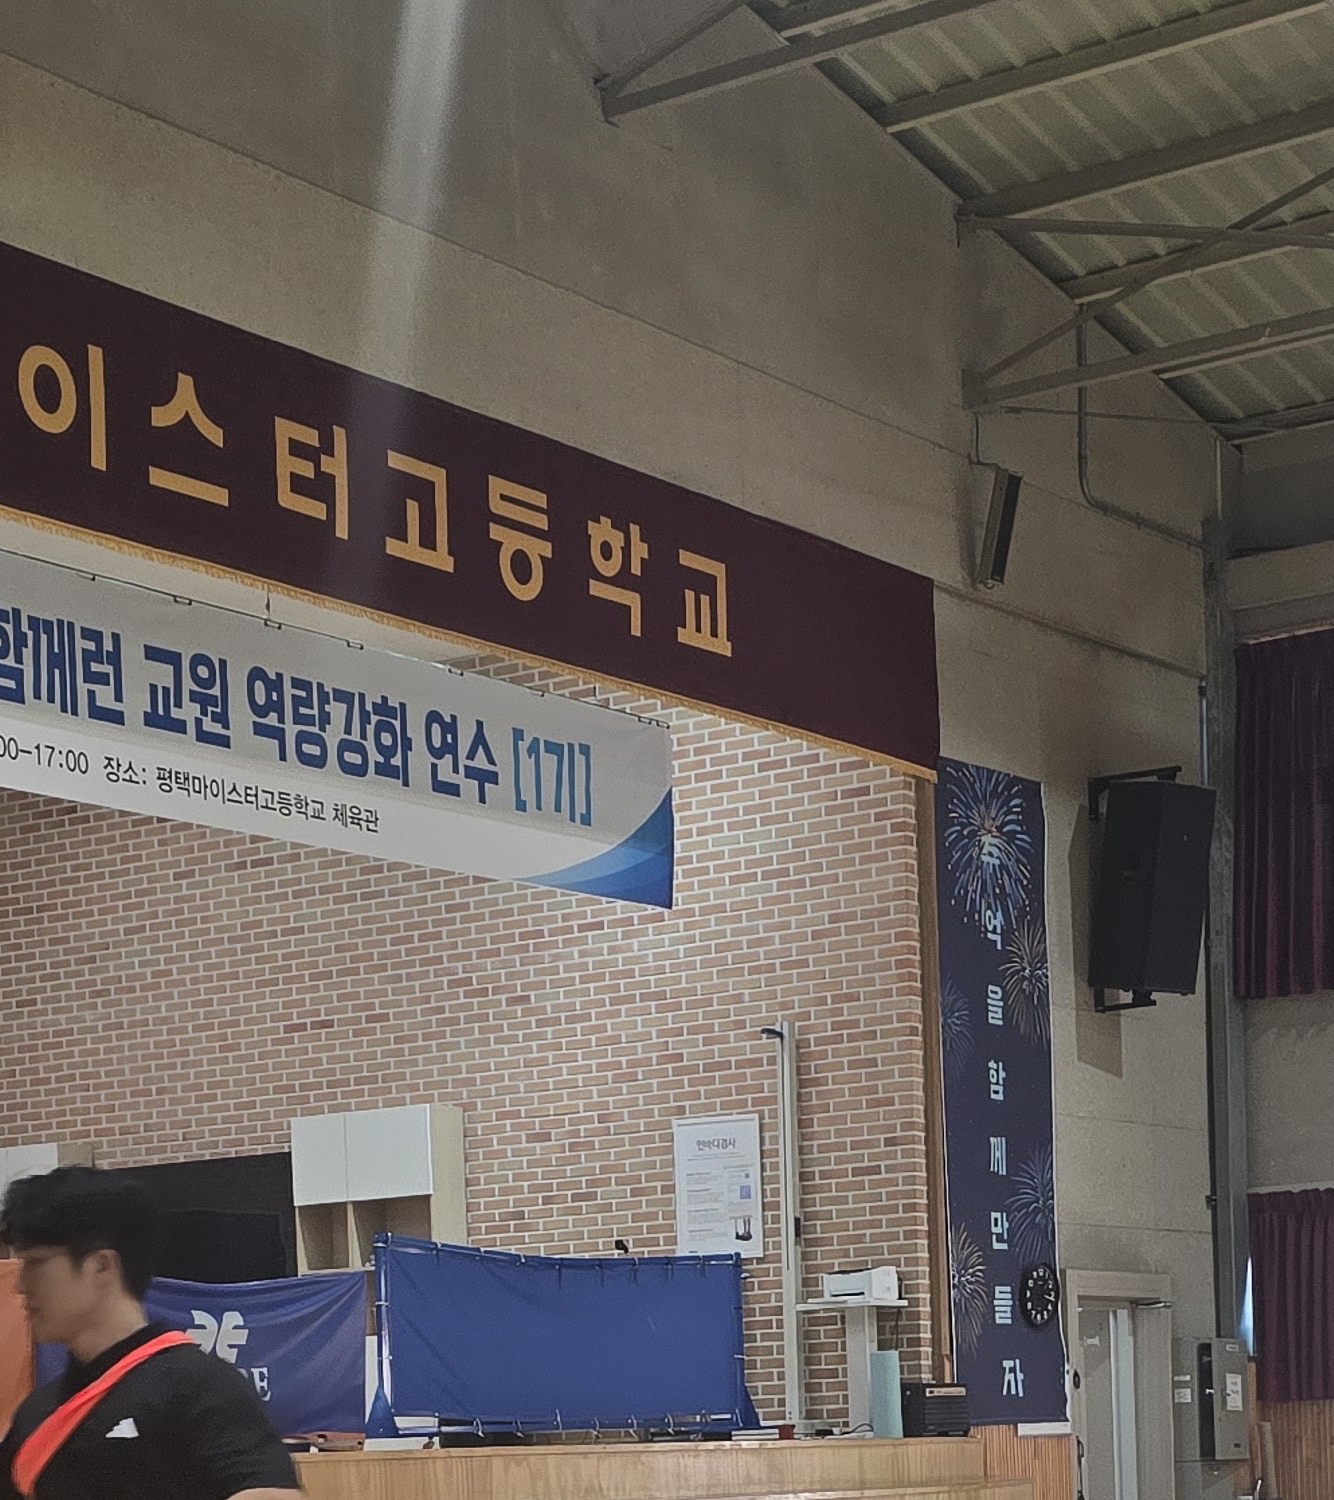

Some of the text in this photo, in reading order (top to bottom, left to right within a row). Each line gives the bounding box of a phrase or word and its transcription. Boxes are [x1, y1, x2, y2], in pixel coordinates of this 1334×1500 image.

[103, 756, 147, 785] 장소:
[156, 766, 326, 822] 평택마이스터고등학교
[332, 803, 379, 833] 체육관
[143, 643, 231, 749] 교원
[247, 664, 412, 787] 역량강화
[425, 707, 499, 804] 연수
[512, 728, 592, 827] [1기]
